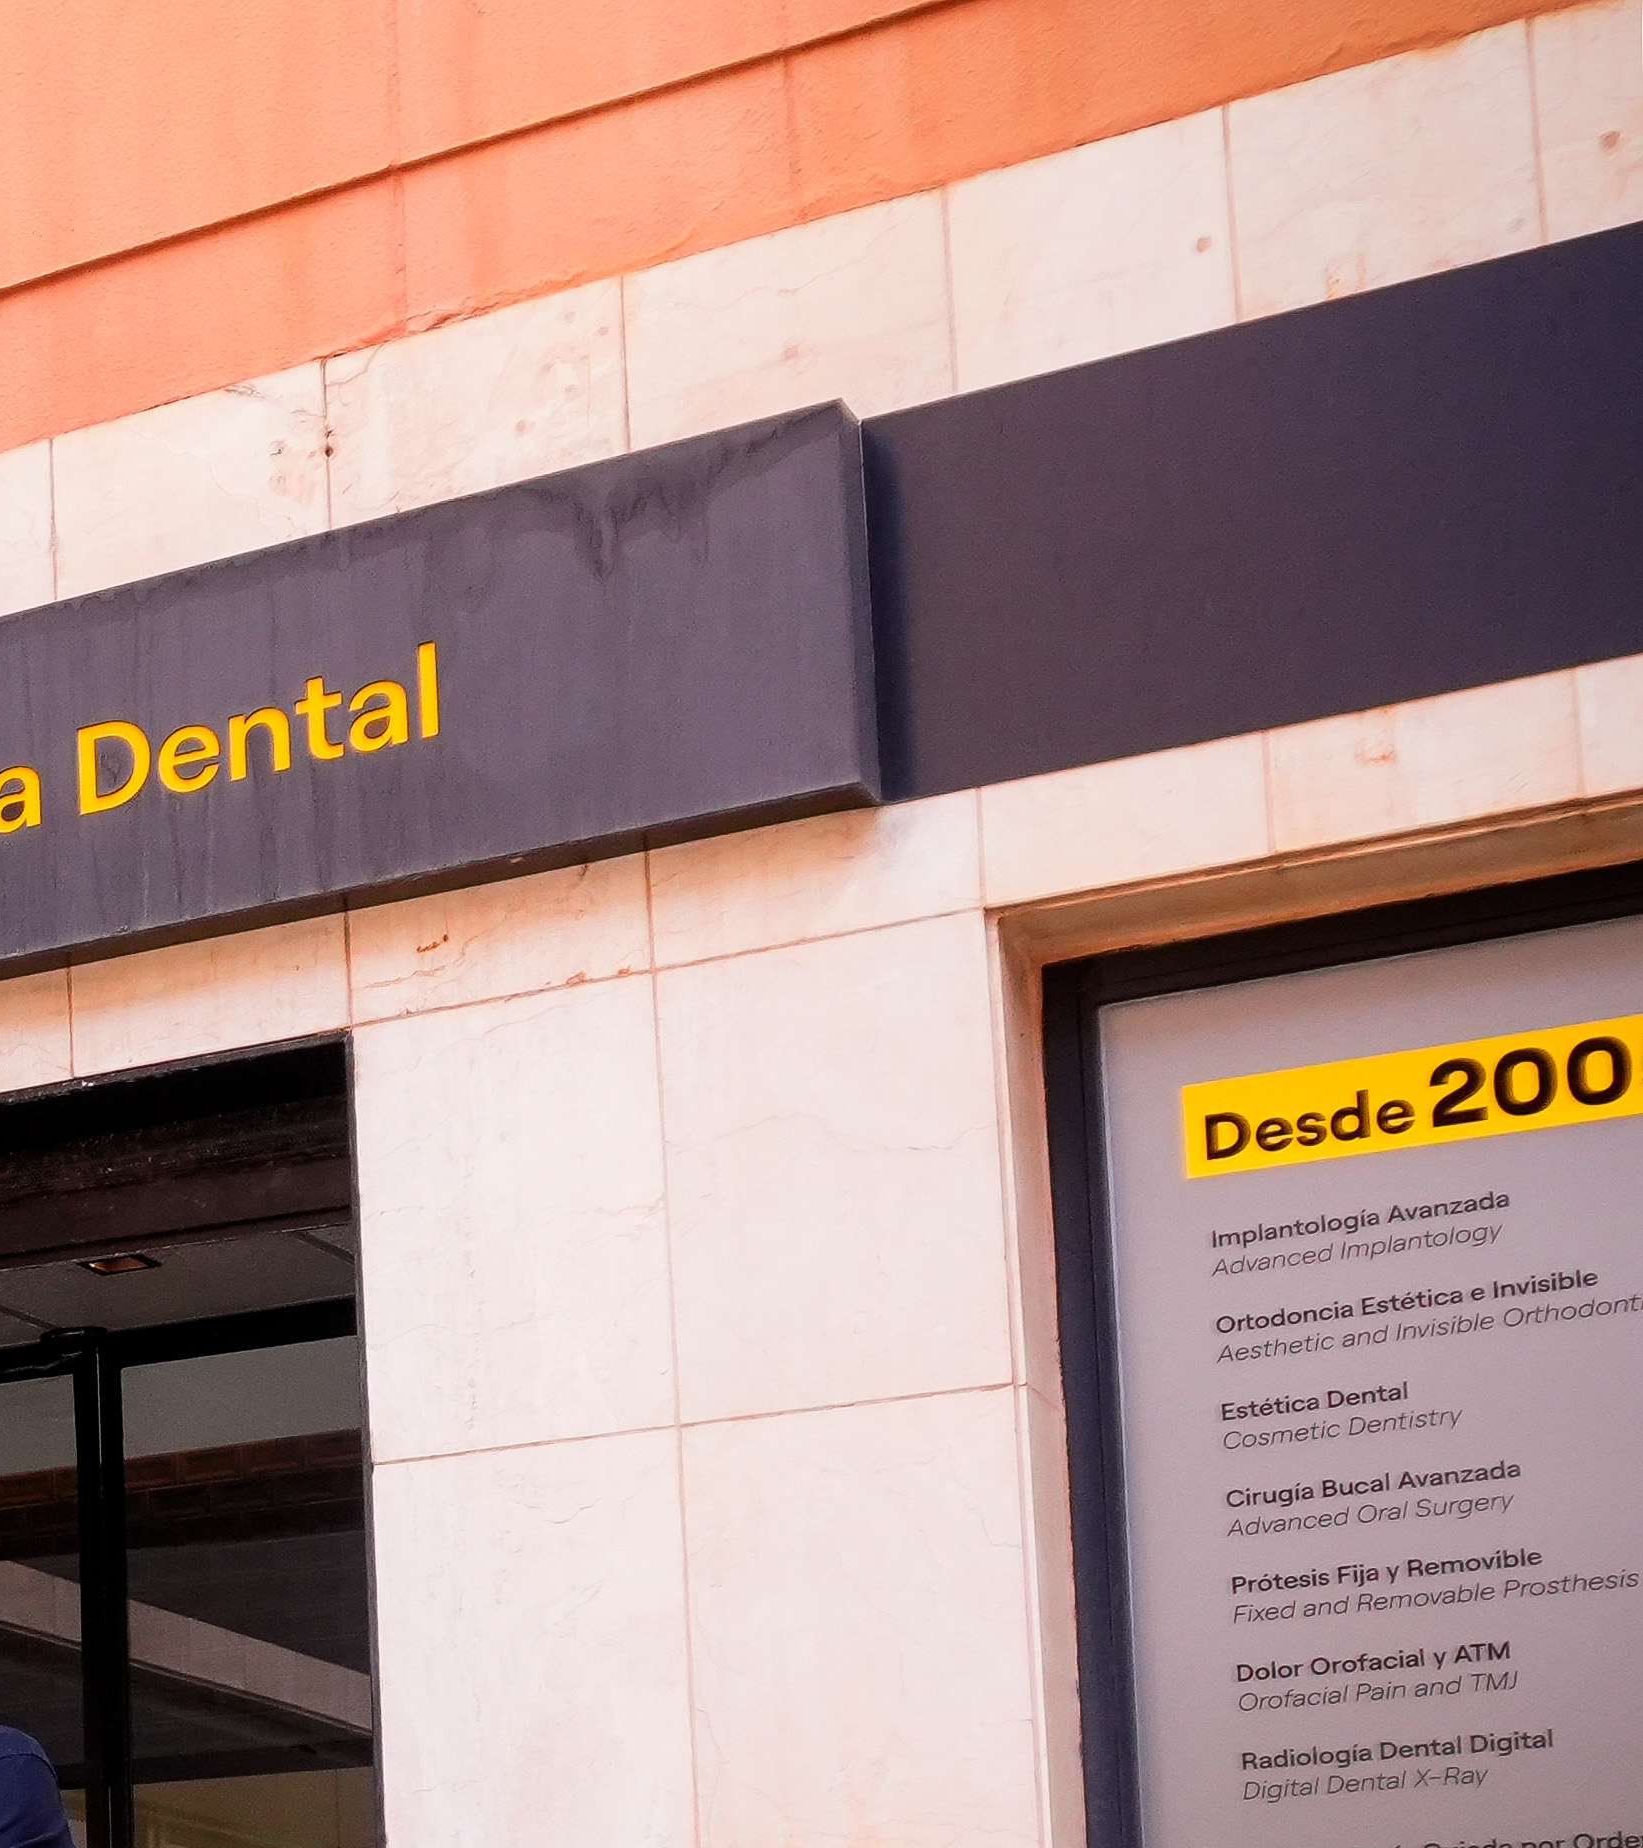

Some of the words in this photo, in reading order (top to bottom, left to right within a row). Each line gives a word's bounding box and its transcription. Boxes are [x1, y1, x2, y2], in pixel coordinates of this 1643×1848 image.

[76, 641, 438, 819] Dental
[1204, 1089, 1415, 1161] Desde
[1212, 1208, 1381, 1249] Implantología
[1387, 1190, 1510, 1223] Avanzada
[1212, 1242, 1333, 1277] Advanced
[1340, 1223, 1504, 1261] Implantology
[1215, 1302, 1353, 1335] Ortodoncia
[1361, 1289, 1464, 1317] Estética
[1470, 1286, 1486, 1302] e
[1492, 1269, 1599, 1300] Invisible
[1217, 1332, 1336, 1364] Aesthetic
[1342, 1325, 1389, 1349] and
[1395, 1311, 1496, 1342] Invisible
[1221, 1394, 1321, 1422] Estética
[1326, 1381, 1410, 1409] Dental
[1222, 1420, 1341, 1450] Cosmetic
[1347, 1406, 1464, 1437] Dentistry
[1226, 1481, 1315, 1509] Cirugía
[1321, 1472, 1391, 1499] Bucal
[1397, 1460, 1522, 1491] Avanzada
[1226, 1506, 1350, 1538] Advanced
[1357, 1500, 1409, 1526] Oral
[1415, 1492, 1515, 1521] Surgery
[1231, 1568, 1331, 1596] Prótesis
[1336, 1563, 1381, 1589] Fija
[1386, 1564, 1400, 1585] y
[1232, 1599, 1296, 1624] Fixed
[1302, 1593, 1349, 1618] and
[1356, 1580, 1497, 1613] Removable
[1502, 1568, 1640, 1600] Prosthesis
[1236, 1658, 1305, 1684] Dolor
[1309, 1646, 1427, 1678] Orofacial
[1432, 1648, 1448, 1670] y
[1453, 1640, 1512, 1666] ATM
[1238, 1684, 1348, 1713] Orofacial
[1355, 1678, 1407, 1702] Pain
[1413, 1675, 1463, 1699] and
[1470, 1669, 1519, 1694] TMJ
[1241, 1742, 1374, 1772] Radiología
[1379, 1735, 1464, 1762] Dental
[1469, 1728, 1555, 1757] Digital
[1242, 1776, 1320, 1804] Digital
[1327, 1767, 1407, 1795] Dental
[1412, 1764, 1490, 1789] X-Ray
